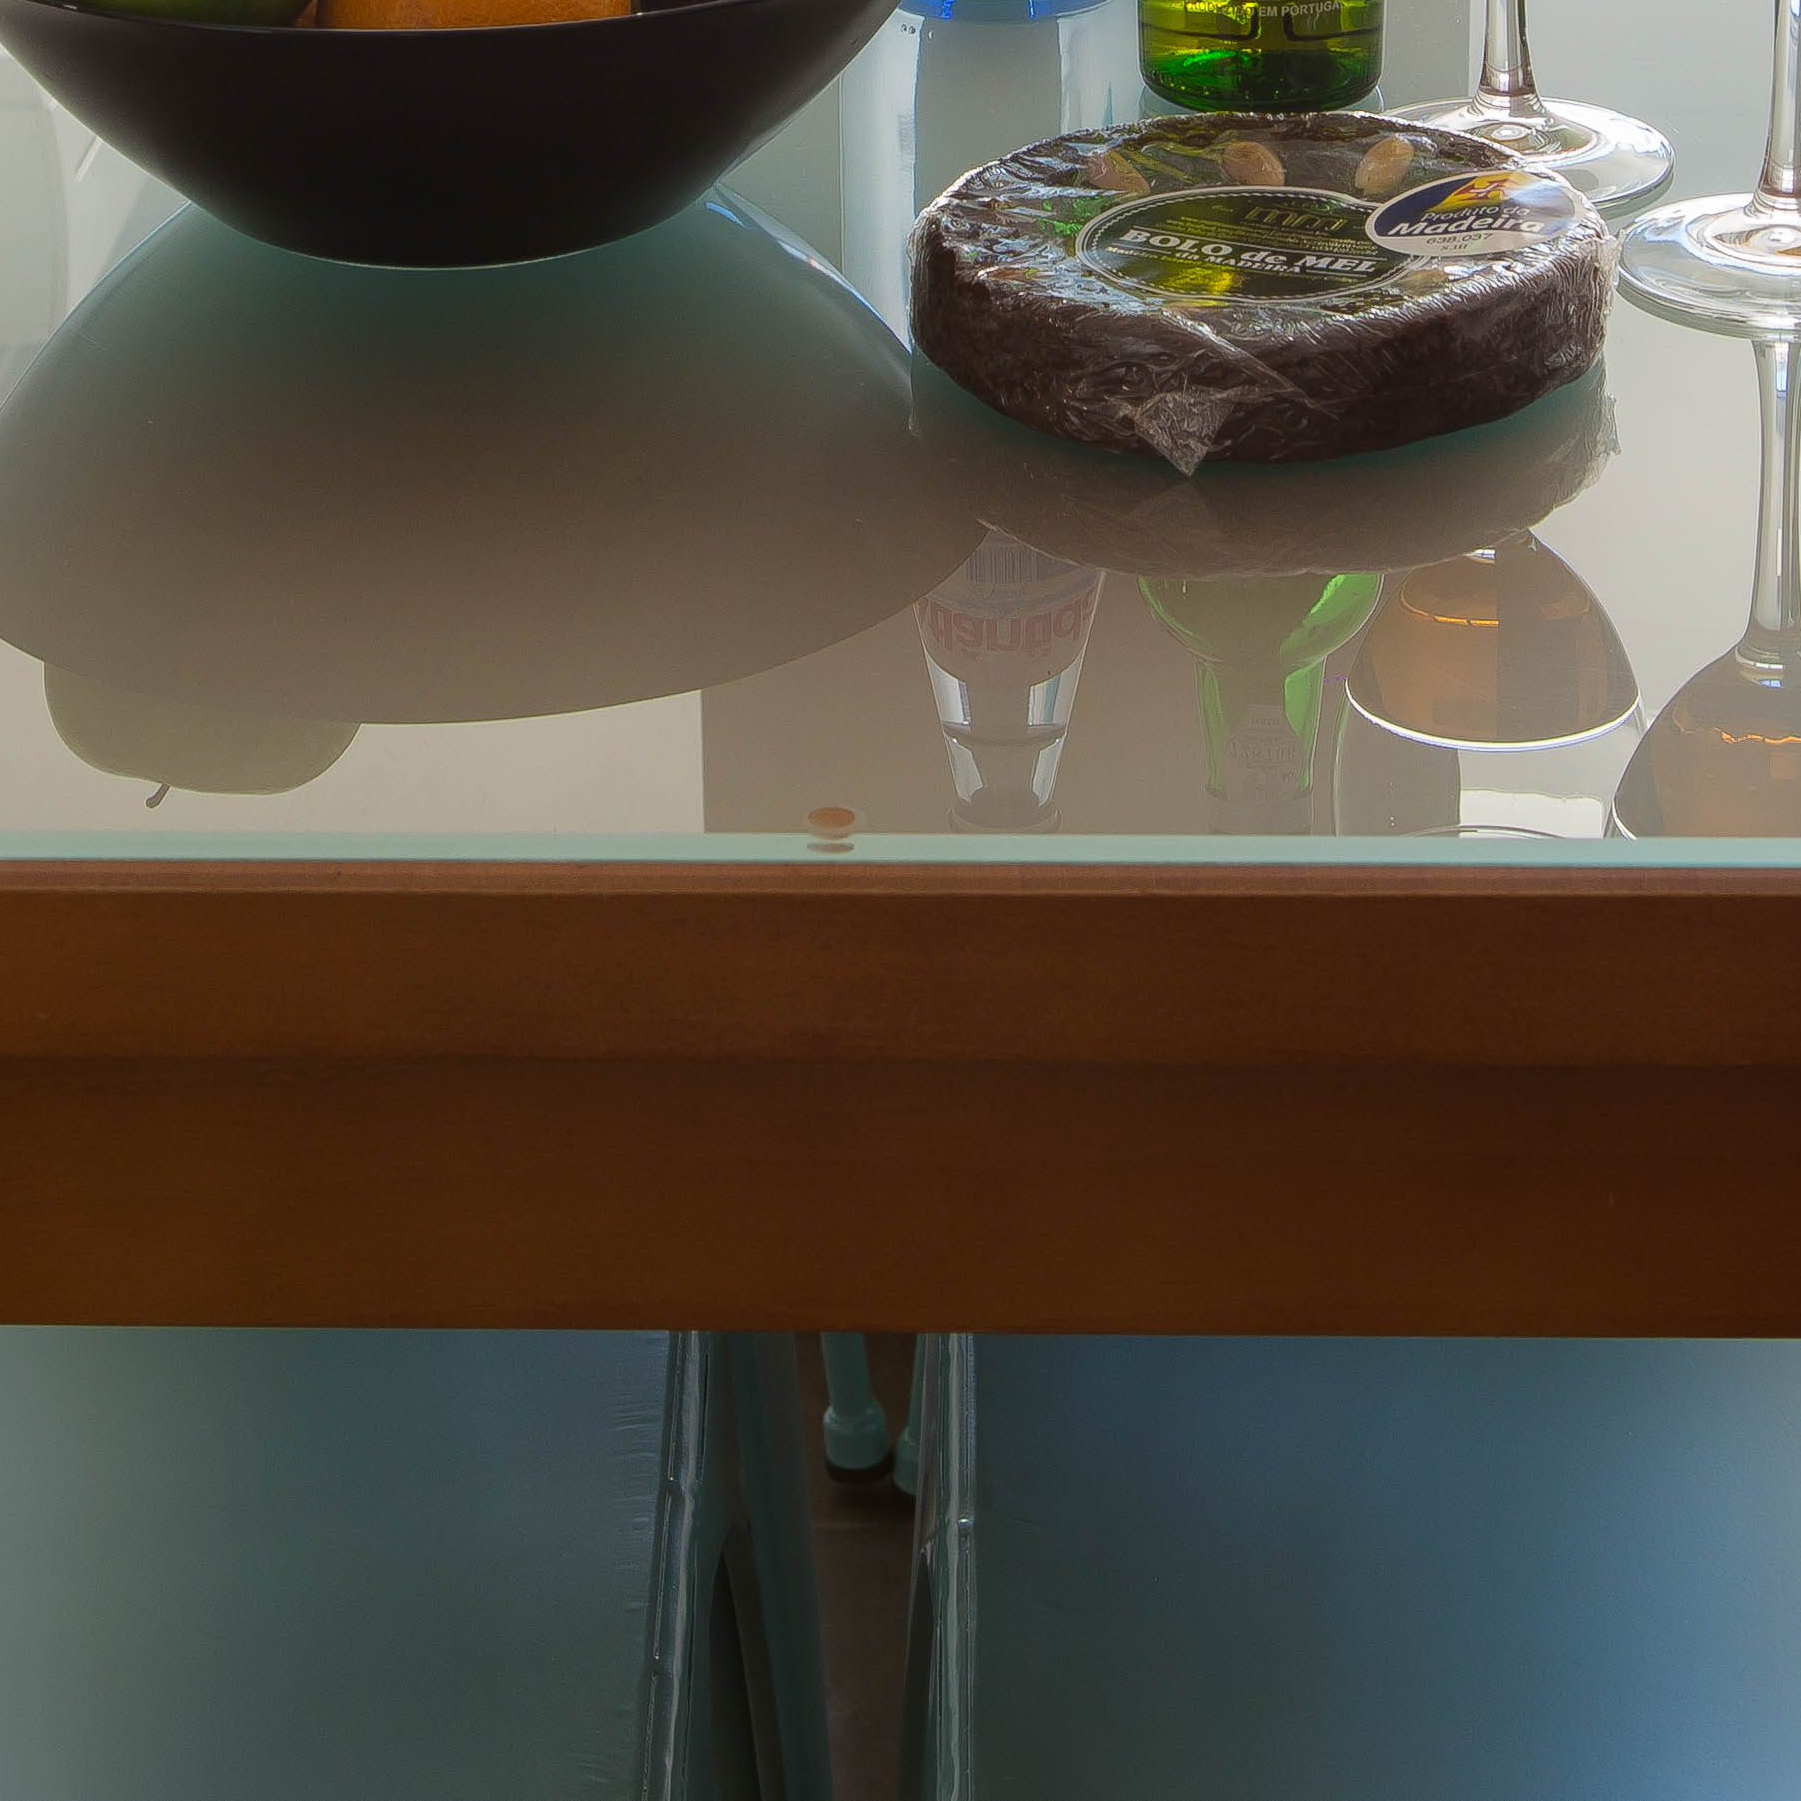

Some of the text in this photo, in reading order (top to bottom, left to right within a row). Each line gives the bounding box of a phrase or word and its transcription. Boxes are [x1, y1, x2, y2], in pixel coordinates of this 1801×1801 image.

[1259, 6, 1278, 17] EM
[1421, 206, 1531, 221] Produto da
[1388, 215, 1545, 235] Madeira
[1119, 229, 1378, 272] BOLO de MEL
[1174, 252, 1200, 261] da
[1204, 255, 1301, 273] MADEIRA
